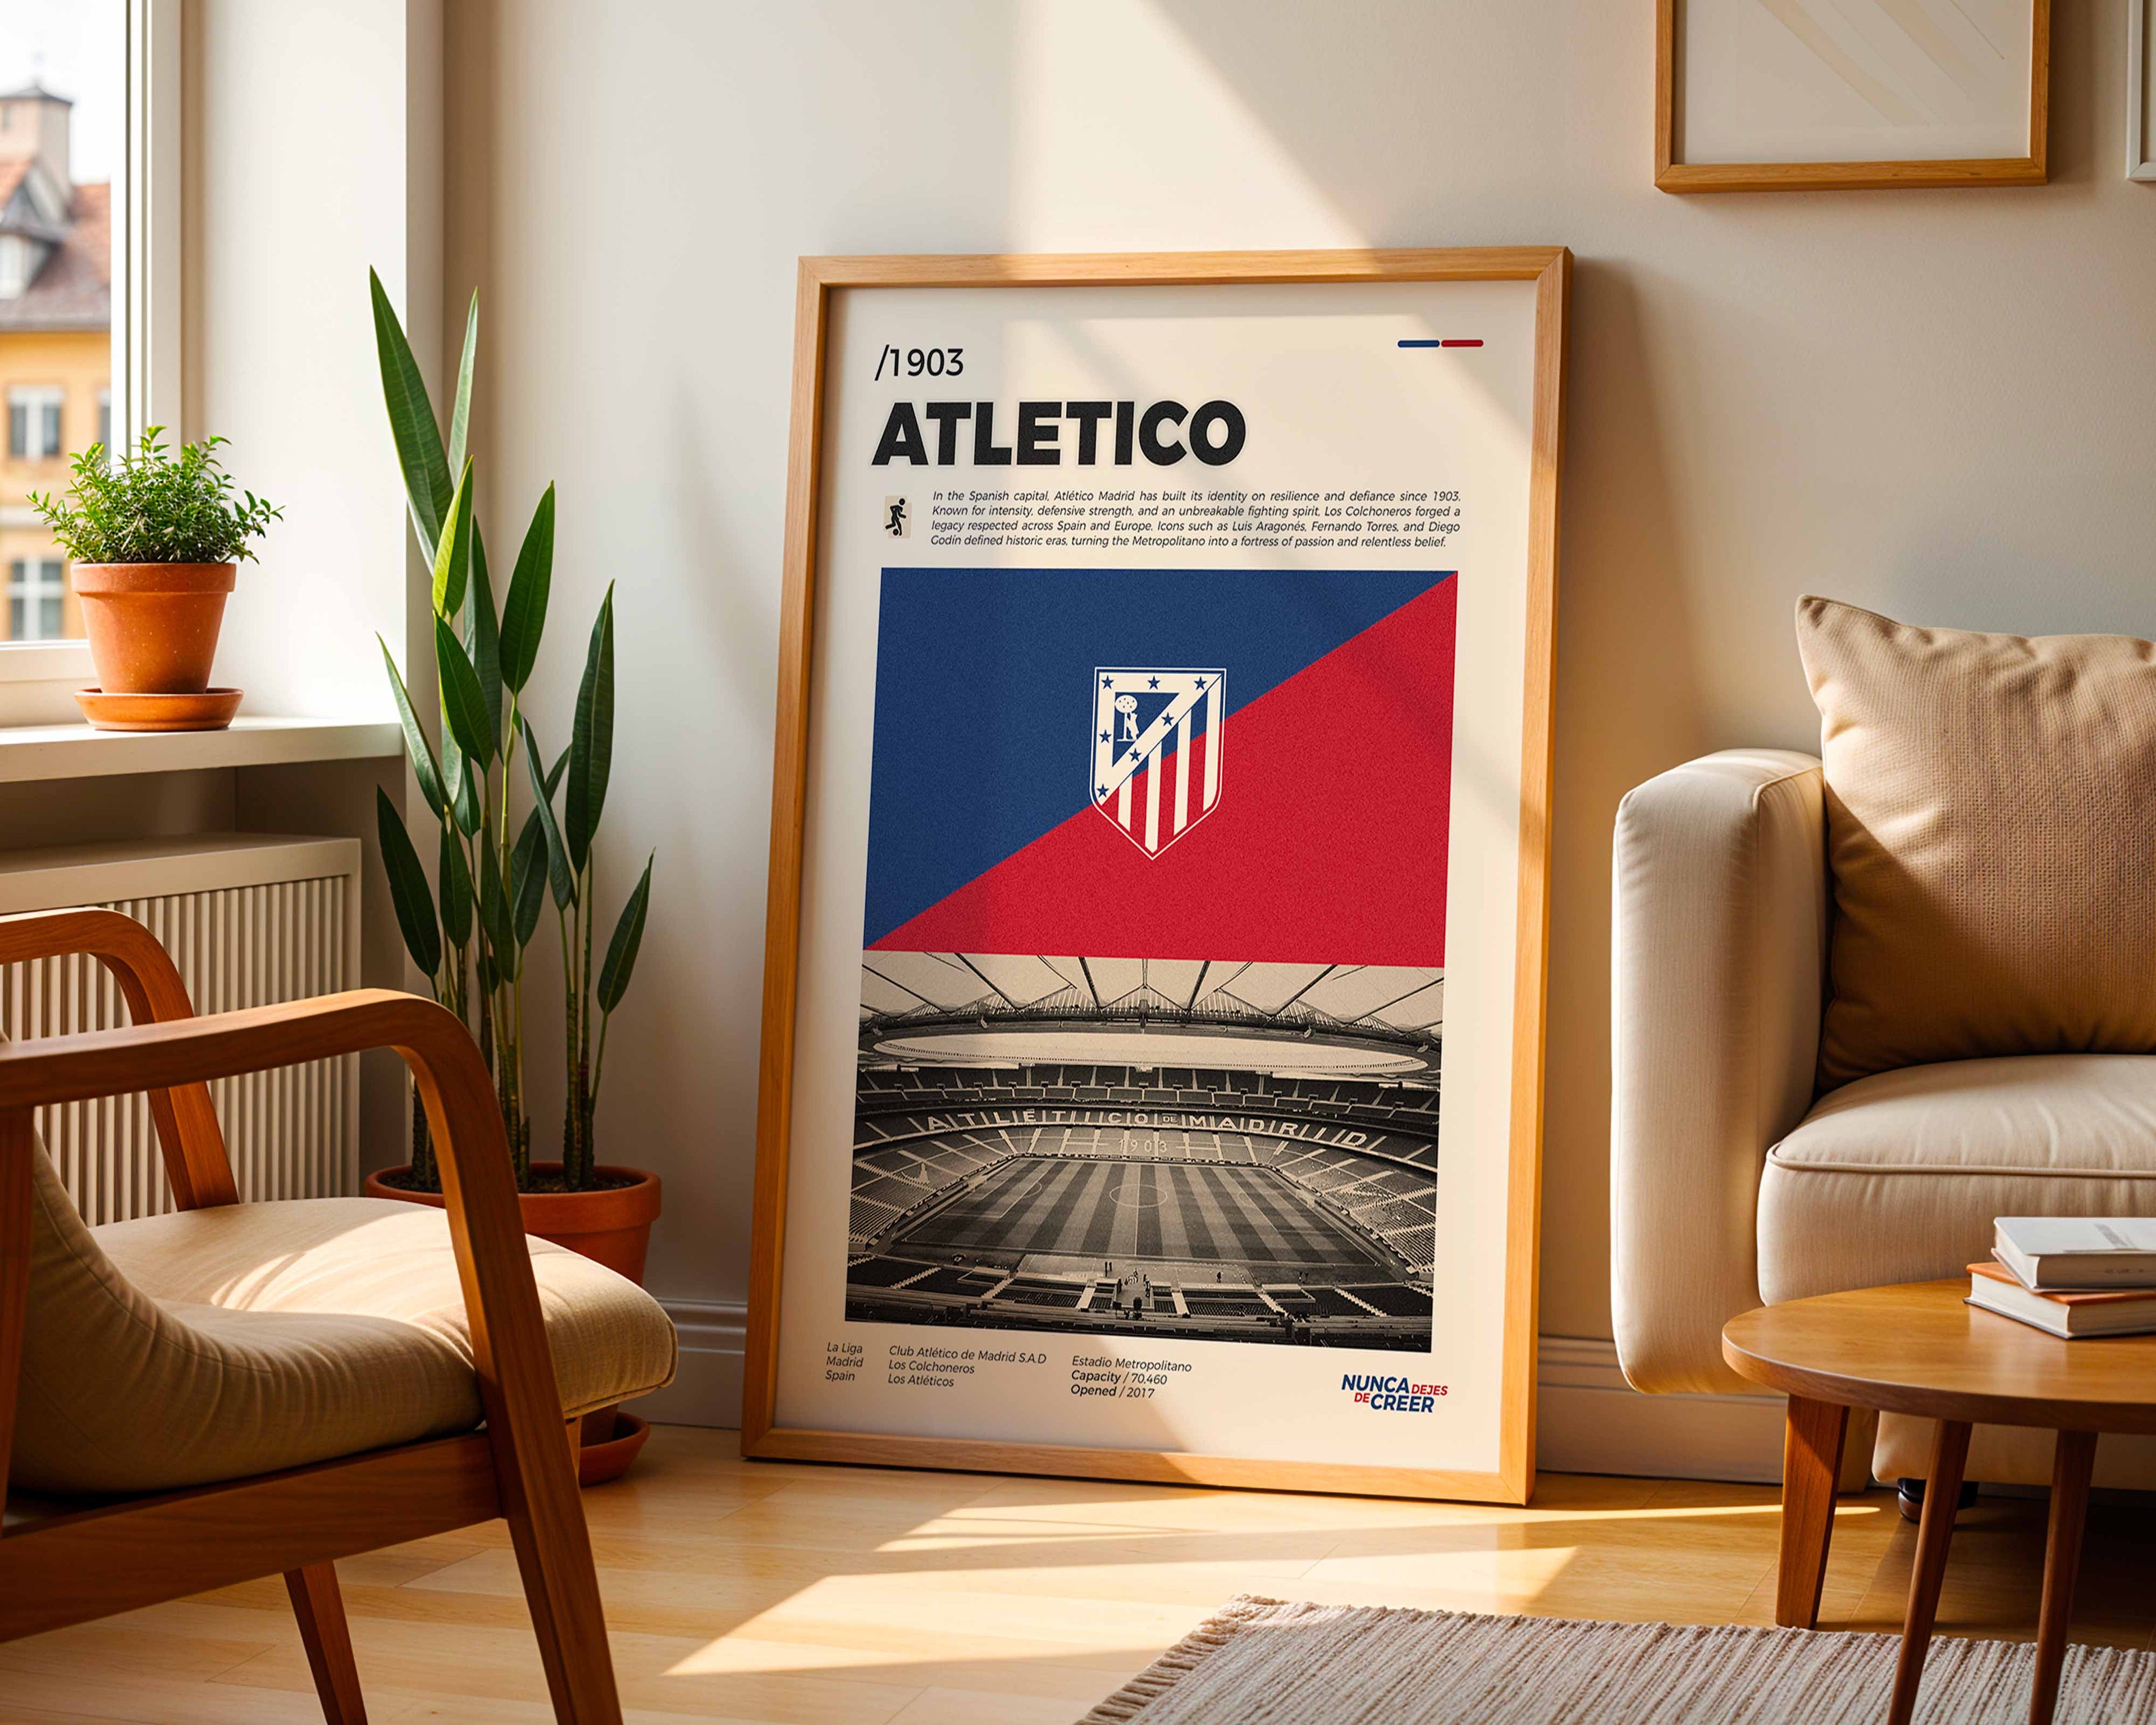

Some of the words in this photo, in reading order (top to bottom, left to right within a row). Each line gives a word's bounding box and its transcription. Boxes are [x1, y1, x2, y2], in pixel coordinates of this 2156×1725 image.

[874, 344, 964, 381] /1903
[871, 399, 1246, 467] ATLETICO
[933, 491, 943, 501] In
[947, 490, 965, 501] the
[969, 490, 1010, 504] Spanish
[1053, 490, 1094, 501] Atlético
[1098, 490, 1136, 501] Madrid
[1139, 490, 1158, 502] has
[1162, 490, 1187, 501] built
[1190, 490, 1203, 502] its
[1207, 490, 1248, 504] identity
[1251, 492, 1266, 502] on
[1270, 490, 1320, 502] resilience
[1323, 490, 1346, 502] and
[1349, 490, 1396, 502] defiance
[1399, 490, 1428, 502] since
[1433, 490, 1461, 502] 1903.
[932, 505, 969, 516] Known
[971, 504, 986, 516] for
[1037, 505, 1086, 517] defensive
[1138, 505, 1159, 517] and
[1161, 507, 1176, 517] an
[1179, 505, 1245, 517] unbreakable
[1248, 505, 1290, 519] fighting
[1324, 505, 1342, 517] Los
[1345, 505, 1412, 517] Colchoneros
[1415, 505, 1451, 519] forged
[1453, 508, 1461, 517] a
[931, 519, 965, 533] legacy
[967, 519, 1019, 533] respected
[1021, 522, 1054, 531] across
[1057, 519, 1087, 533] Spain
[1089, 520, 1111, 531] and
[1114, 520, 1153, 533] Europe.
[1157, 521, 1185, 532] Icons
[1187, 520, 1213, 532] such
[1216, 522, 1228, 532] as
[1232, 520, 1253, 532] Luis
[1311, 521, 1363, 532] Fernando
[1403, 521, 1425, 532] and
[1428, 521, 1461, 535] Diego
[963, 534, 1004, 546] defined
[1006, 535, 1044, 546] historic
[1071, 535, 1109, 549] turning
[1112, 535, 1130, 546] the
[1132, 535, 1206, 549] Metropolitano
[1208, 535, 1230, 547] into
[1231, 537, 1238, 547] a
[1240, 535, 1279, 547] fortress
[1281, 535, 1294, 547] of
[1294, 535, 1335, 549] passion
[1336, 536, 1359, 547] and
[1360, 536, 1412, 547] relentless
[1414, 536, 1446, 547] belief.
[1189, 1115, 1367, 1146] MADRID
[826, 1342, 839, 1352] La
[841, 1343, 863, 1356] Liga
[889, 1345, 915, 1357] Club
[916, 1347, 958, 1359] Atlético
[960, 1349, 975, 1360] de
[977, 1350, 1017, 1363] Madrid
[826, 1356, 864, 1368] Madrid
[888, 1359, 906, 1370] Los
[908, 1360, 975, 1374] Colchoneros
[1072, 1355, 1112, 1368] Estadio
[1114, 1358, 1193, 1372] Metropolitano
[825, 1370, 855, 1382] Spain
[888, 1373, 906, 1384] Los
[907, 1374, 954, 1388] Atléticos
[1071, 1369, 1122, 1385] Capacity
[1071, 1384, 1117, 1397] Opened
[1126, 1386, 1155, 1399] 2017
[1341, 1374, 1409, 1394] NUNCA
[1411, 1384, 1448, 1396] DEJES
[1354, 1392, 1371, 1403] DE
[1371, 1393, 1435, 1413] CREER
